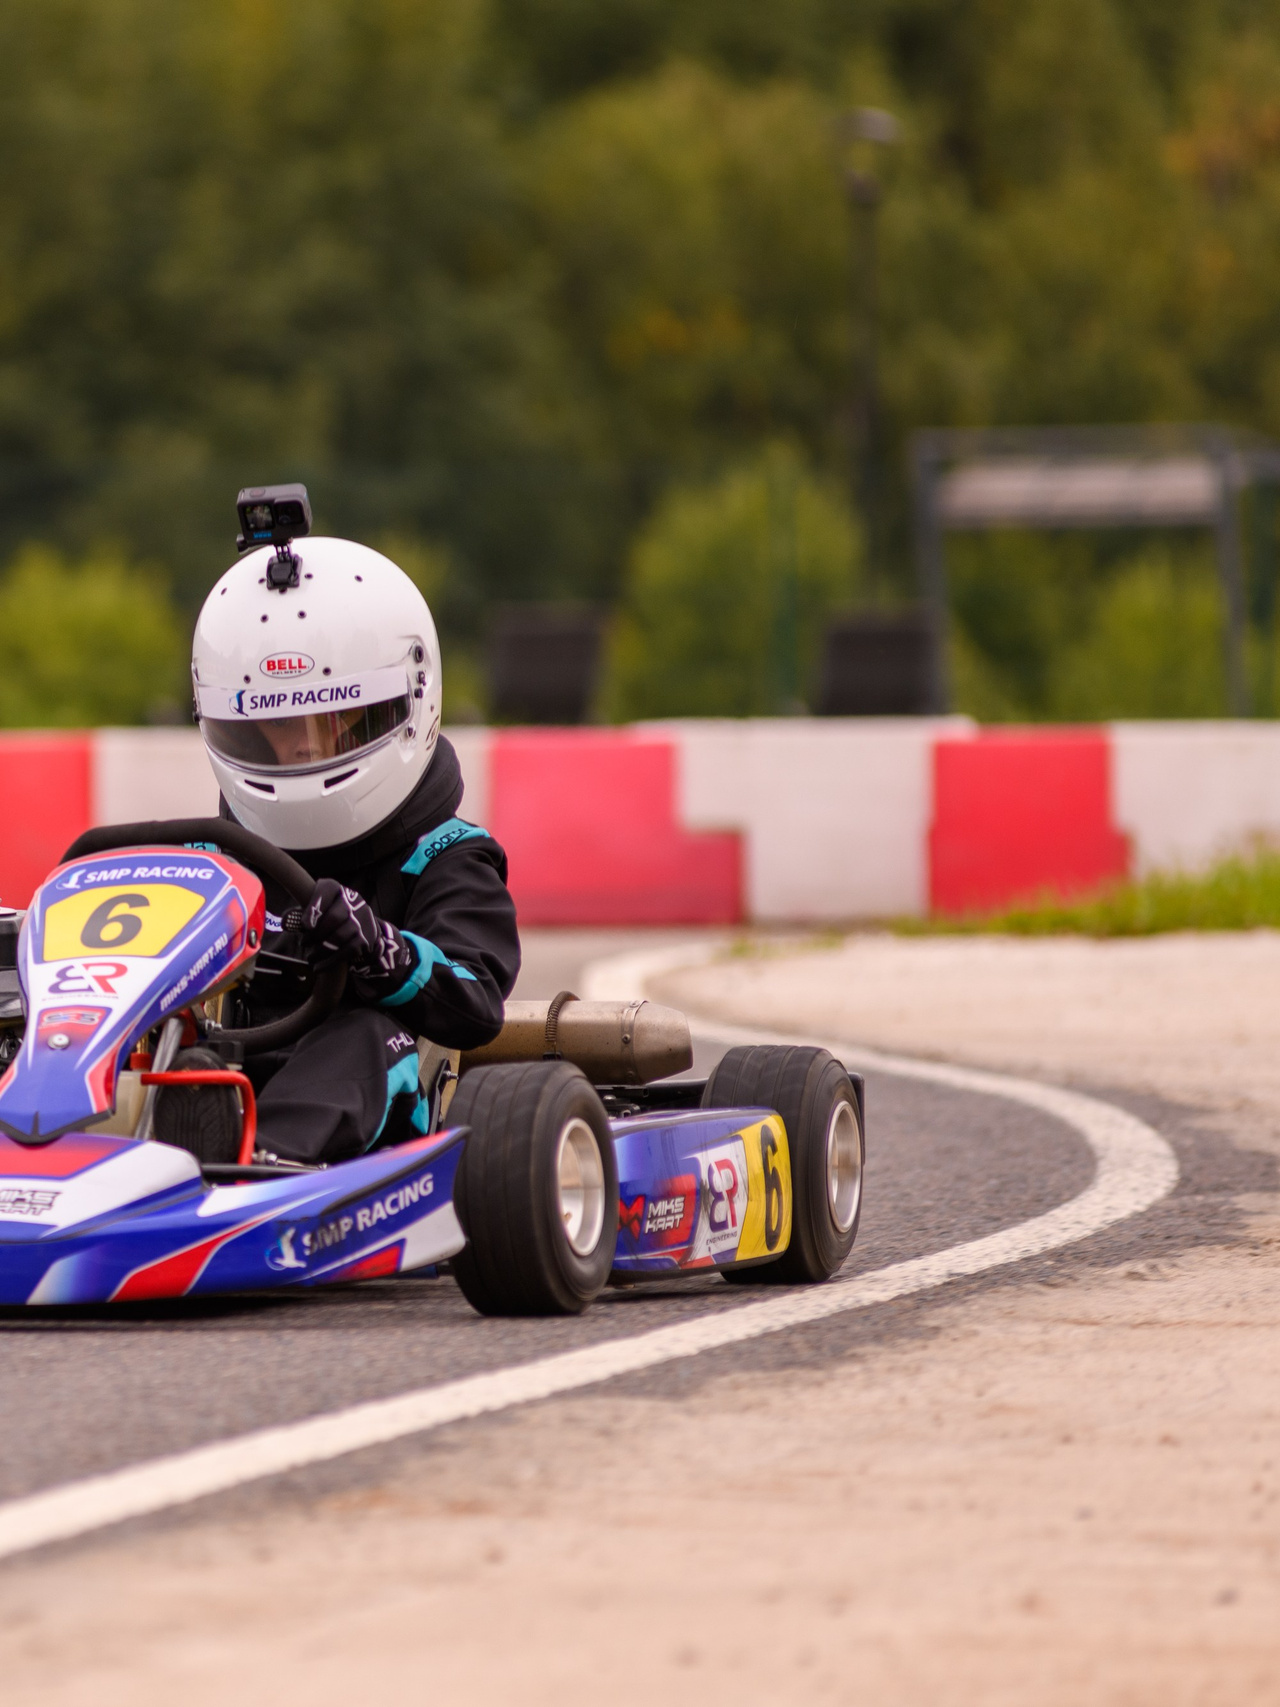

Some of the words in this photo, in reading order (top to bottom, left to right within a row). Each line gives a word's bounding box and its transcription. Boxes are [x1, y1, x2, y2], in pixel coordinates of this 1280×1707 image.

[266, 657, 307, 672] BELL
[250, 693, 288, 710] SMP
[291, 684, 362, 706] RACING
[84, 867, 132, 884] SMP
[132, 866, 216, 880] RACING
[80, 893, 151, 949] 6
[760, 1124, 784, 1251] 6
[301, 1216, 354, 1257] SMP
[356, 1172, 435, 1232] RACING
[648, 1196, 686, 1219] MIKS
[644, 1213, 685, 1235] KART
